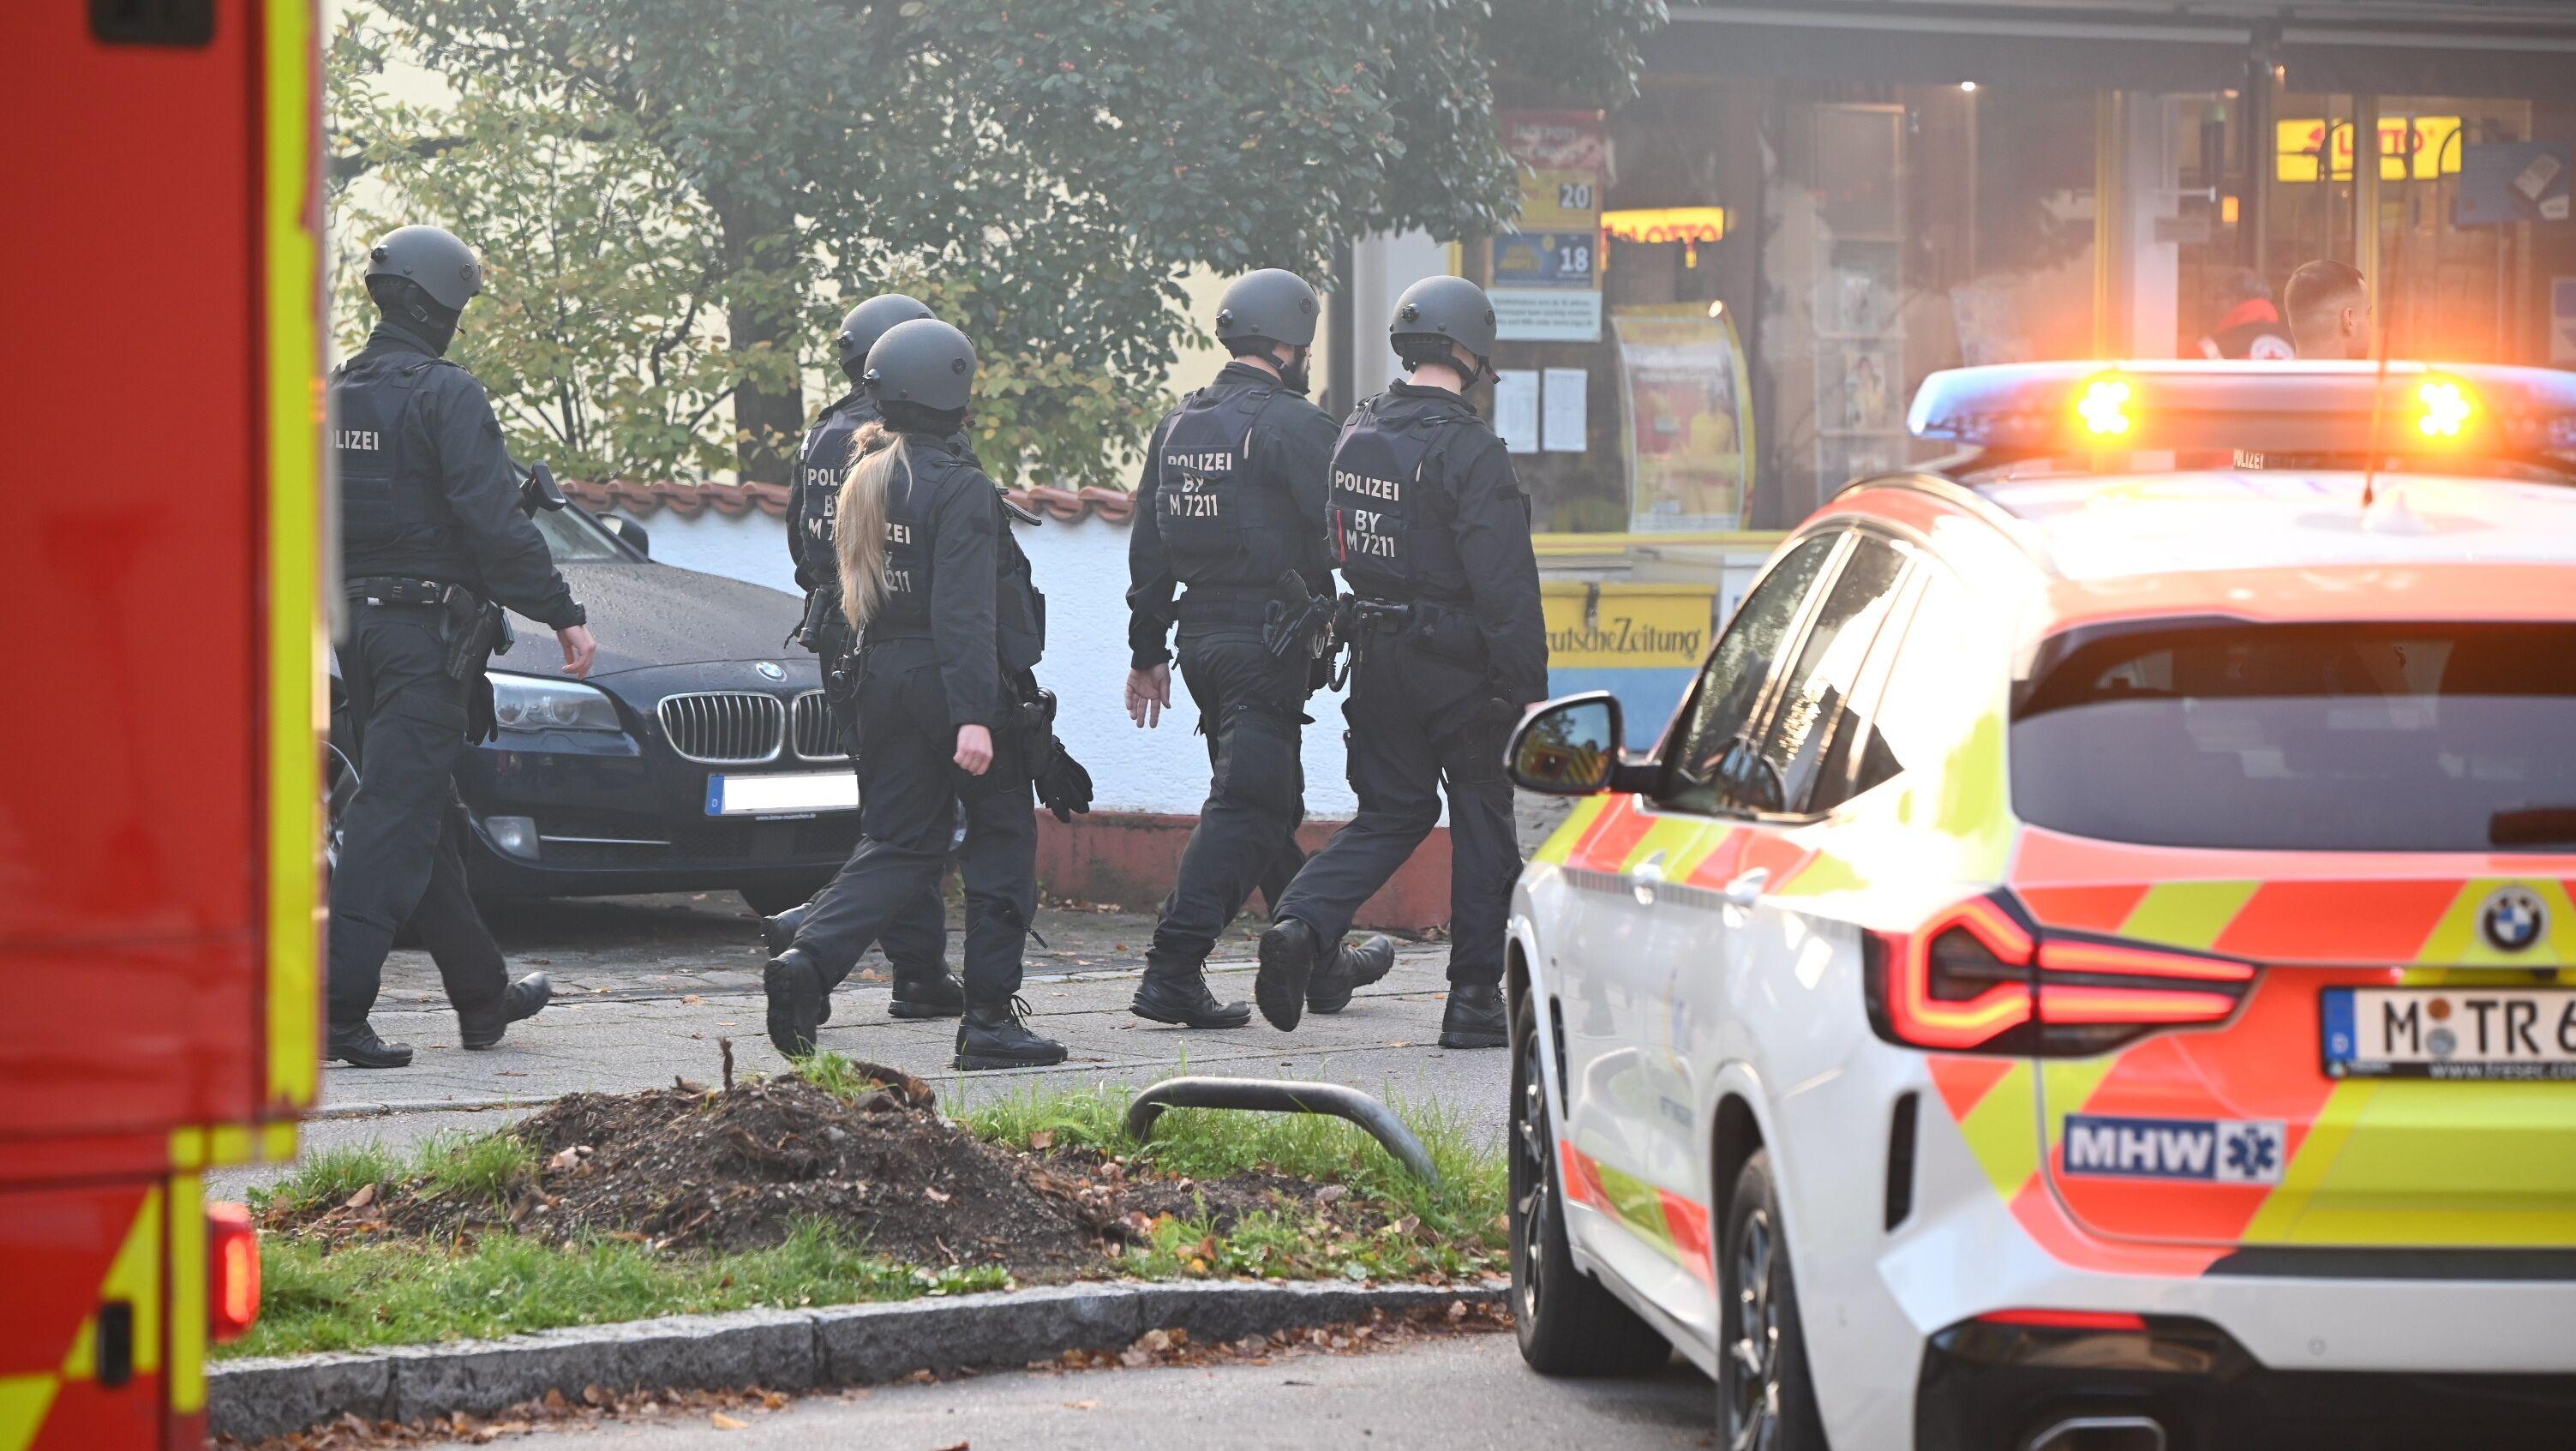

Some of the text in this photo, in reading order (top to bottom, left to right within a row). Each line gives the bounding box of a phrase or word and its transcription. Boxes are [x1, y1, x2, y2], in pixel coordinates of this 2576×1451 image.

[2339, 130, 2423, 154] LTTO
[1562, 183, 1590, 208] 20
[1561, 246, 1590, 273] 18
[330, 429, 379, 450] LIZEI
[1167, 453, 1232, 471] POLIZEI
[1182, 472, 1204, 493] BY
[1335, 470, 1399, 501] POLIZEI
[1169, 494, 1218, 517] M 7211
[808, 518, 823, 540] M
[1355, 509, 1383, 533] BY
[1346, 529, 1395, 558] M 7211
[885, 570, 912, 593] 211
[2383, 1000, 2420, 1054] M
[2465, 999, 2541, 1055] TR
[2070, 1125, 2214, 1172] MHW
